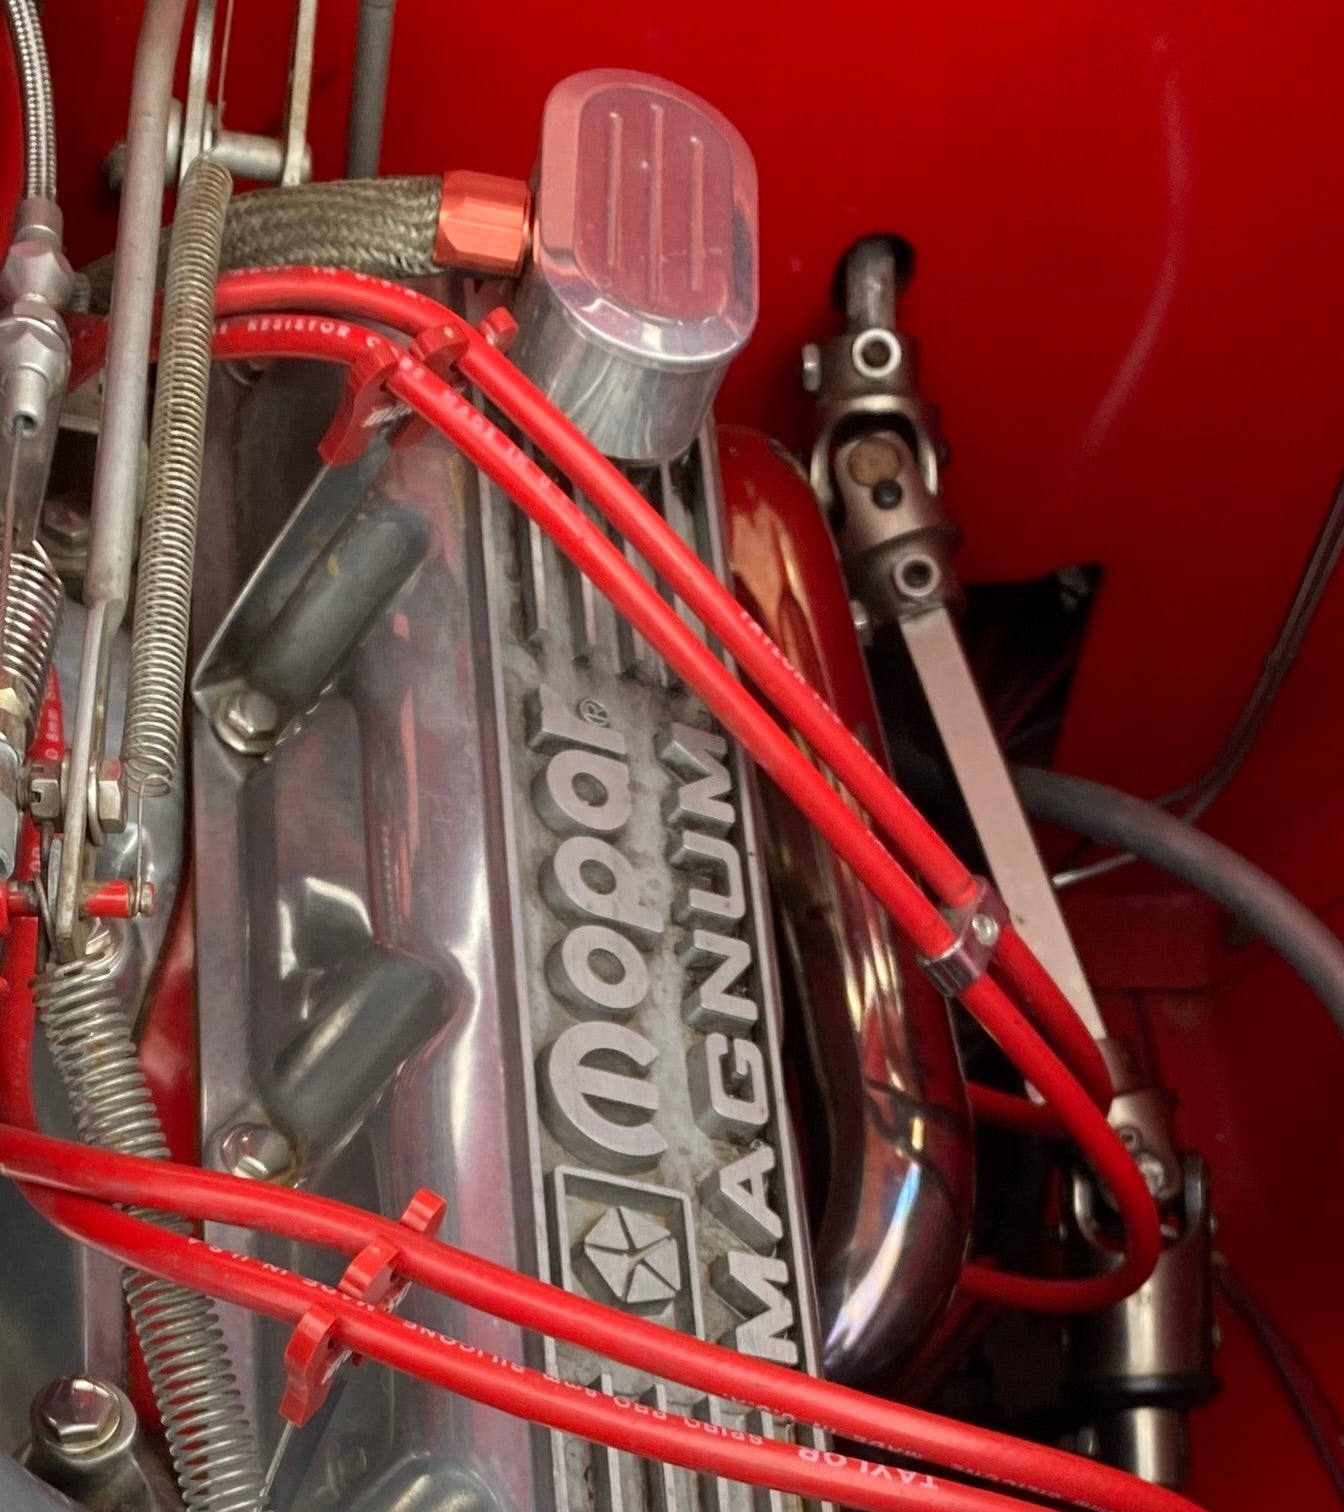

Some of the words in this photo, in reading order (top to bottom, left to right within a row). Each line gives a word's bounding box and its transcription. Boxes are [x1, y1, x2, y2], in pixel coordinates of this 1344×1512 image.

[246, 317, 351, 339] RESISTOR
[666, 720, 800, 1365] MAGNUM
[798, 1446, 940, 1491] TAYLOR
